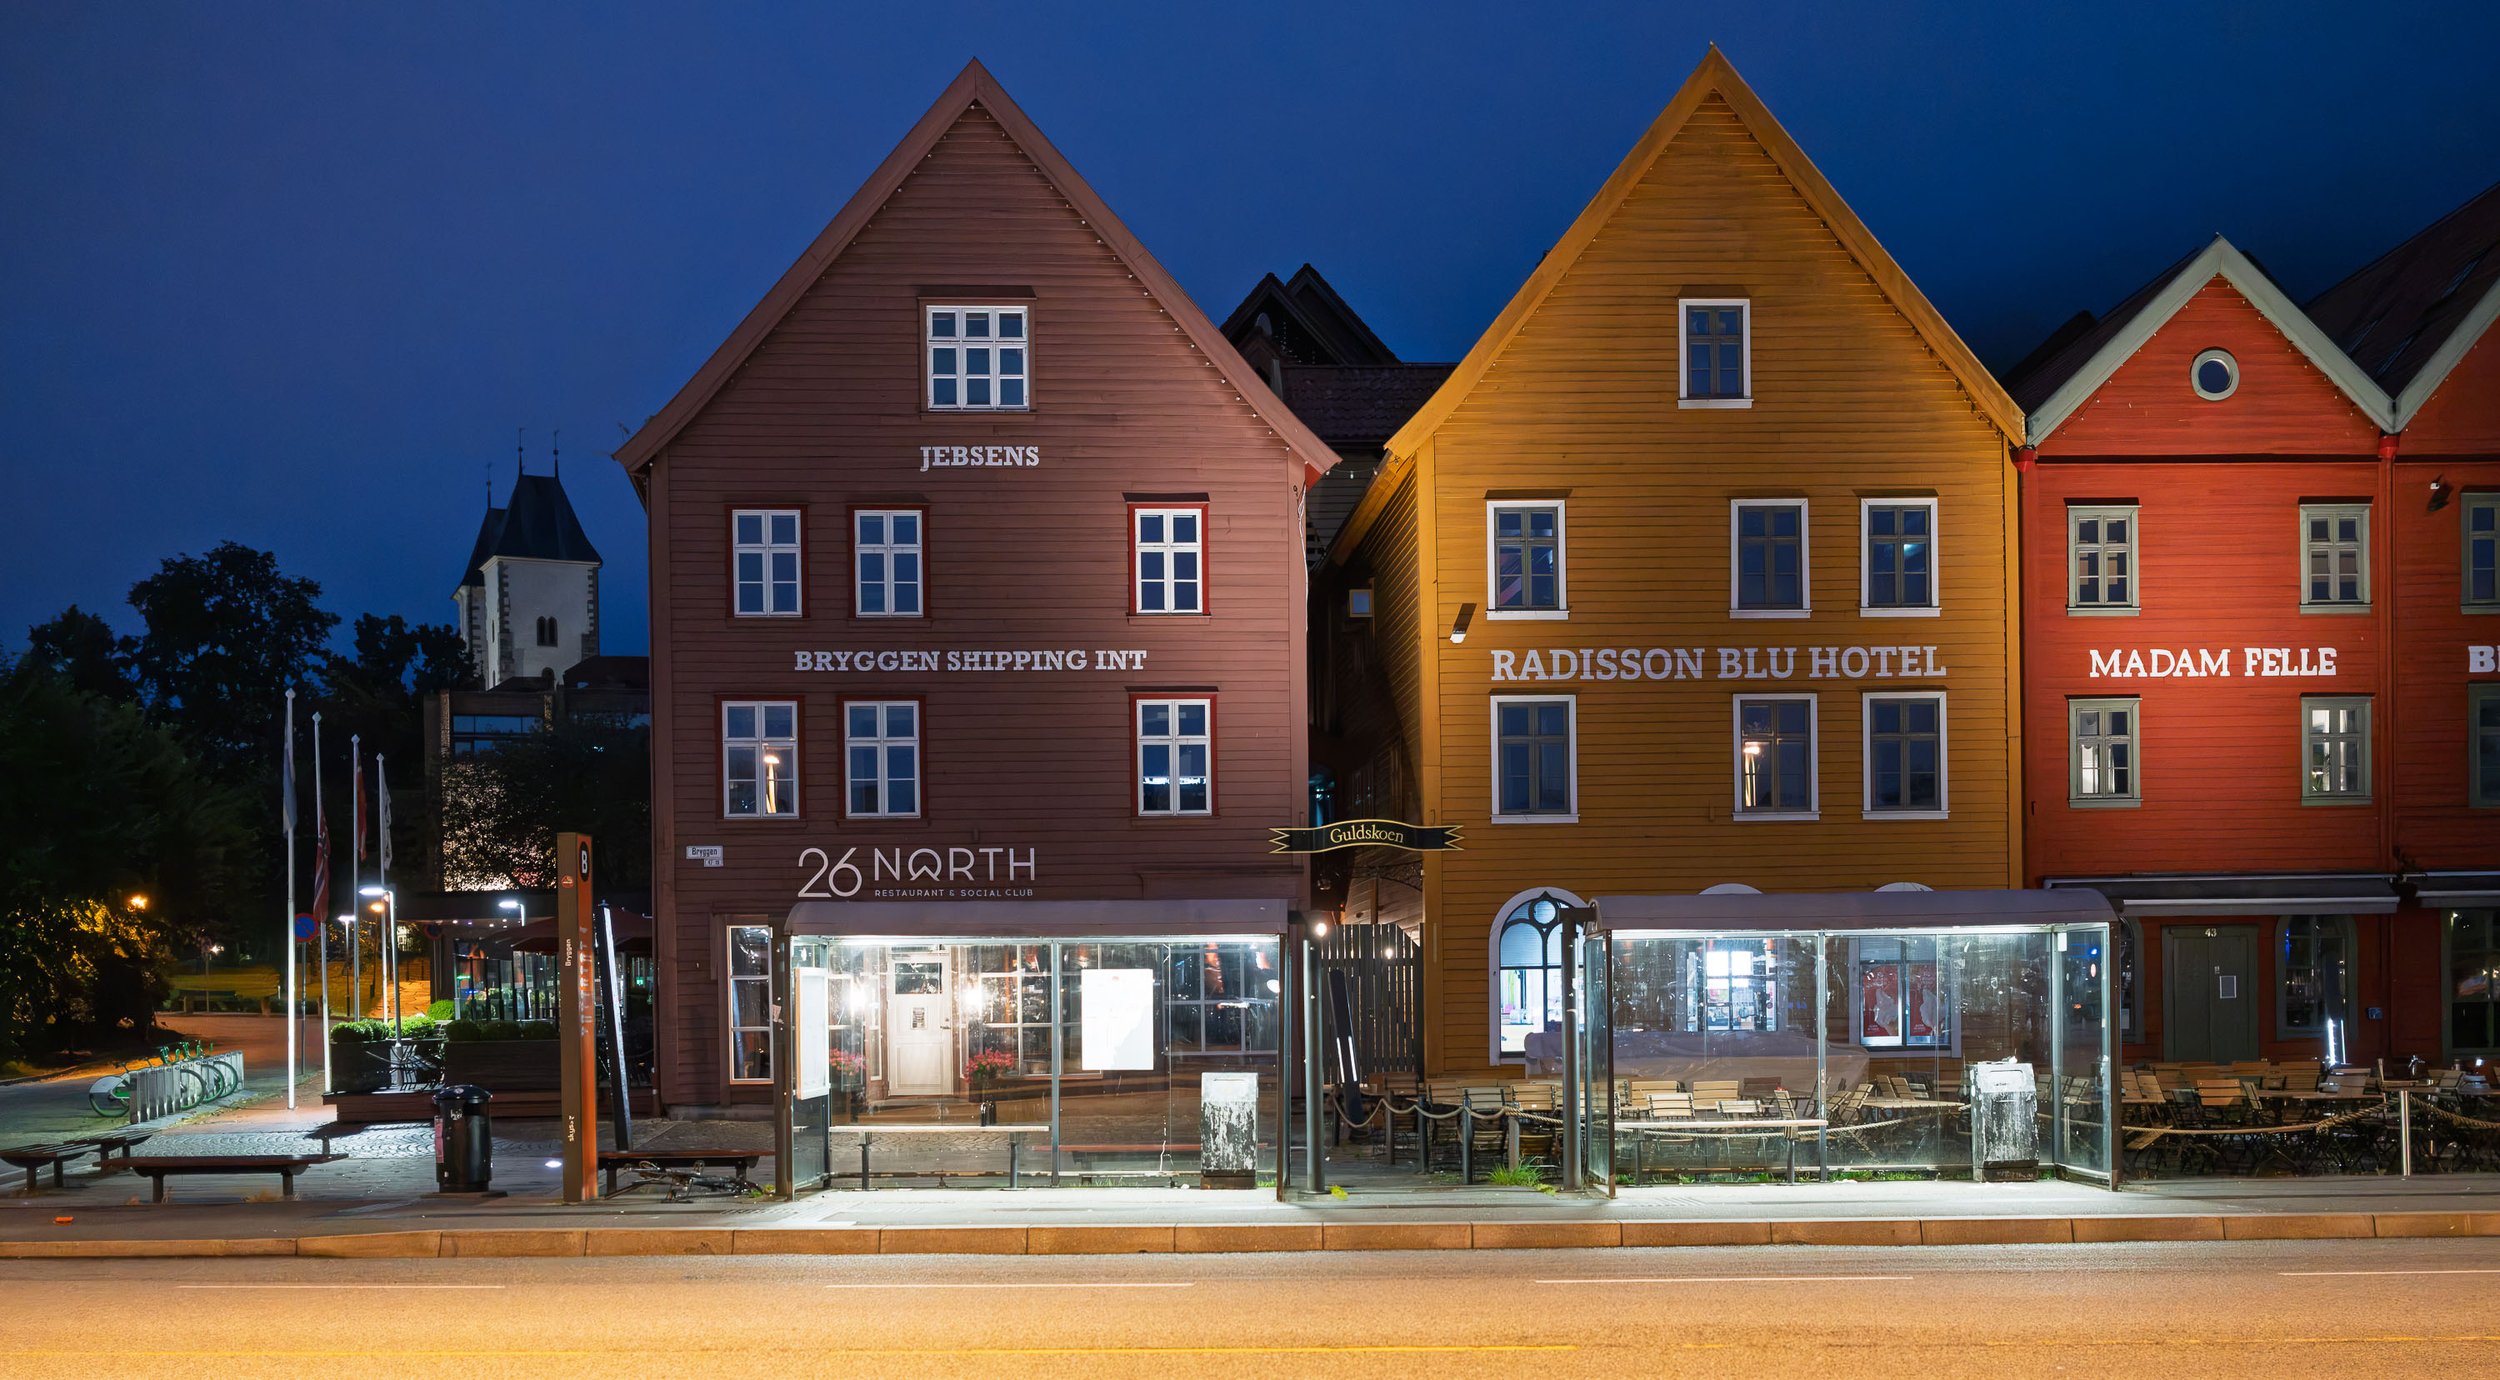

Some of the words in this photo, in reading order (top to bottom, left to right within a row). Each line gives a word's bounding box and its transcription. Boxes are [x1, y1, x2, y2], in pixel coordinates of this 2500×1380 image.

[920, 446, 1039, 472] JEBSENS
[794, 650, 940, 671] BRYGGEN
[947, 650, 1088, 671] SHIPPING
[1095, 649, 1147, 670] INT
[1490, 648, 1705, 681] RADISSON
[1717, 647, 1797, 678] BLU
[1808, 646, 1946, 678] HOTEL
[2089, 649, 2231, 677] MADAM
[2244, 647, 2337, 676] FELLE
[2468, 645, 2500, 673] B
[1330, 824, 1404, 844] Guldskoen
[581, 850, 588, 874] B
[691, 847, 718, 857] Bryggen
[798, 848, 863, 898] 26
[874, 848, 1036, 881] NORTH
[875, 889, 944, 897] RESTAURANT
[949, 889, 955, 897] &
[960, 889, 1002, 897] SOCIAL
[1005, 889, 1034, 897] CLUB
[2205, 928, 2217, 937] 43
